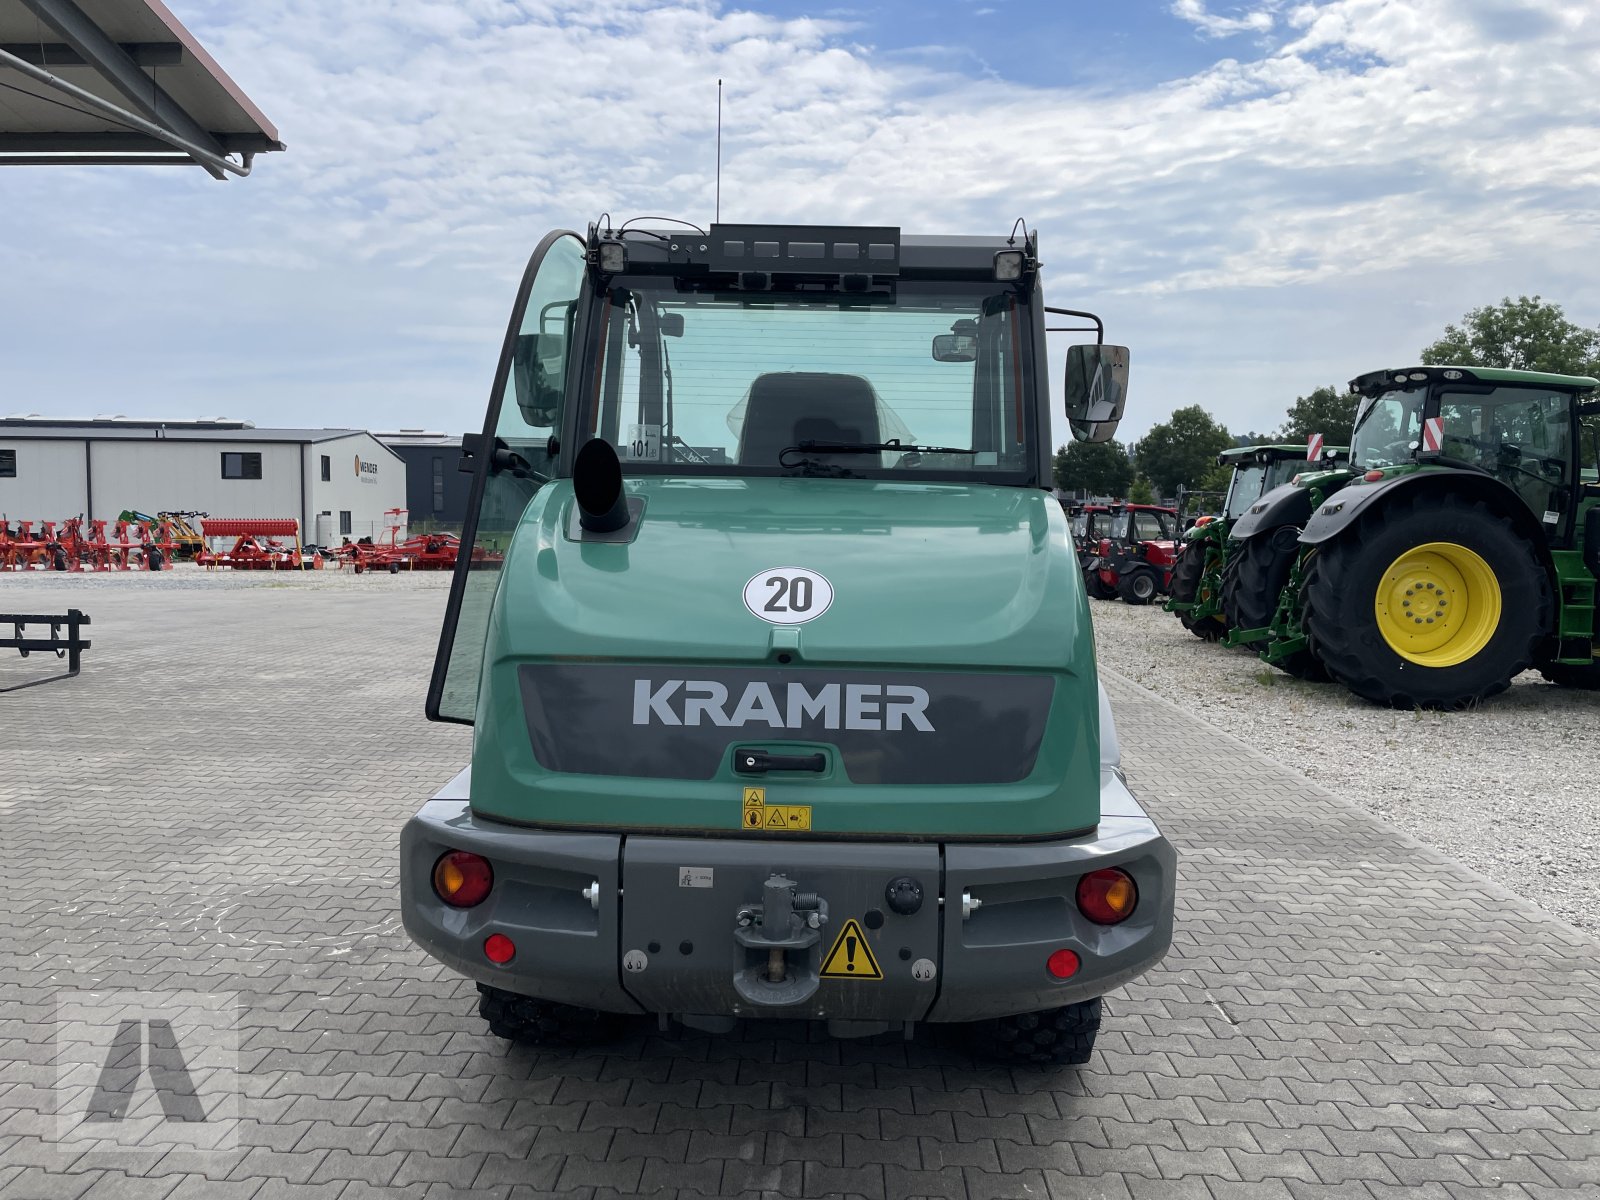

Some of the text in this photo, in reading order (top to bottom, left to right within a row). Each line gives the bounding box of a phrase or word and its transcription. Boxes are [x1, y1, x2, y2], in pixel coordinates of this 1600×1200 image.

[632, 439, 649, 457] 101
[360, 461, 378, 474] WENDER
[763, 576, 813, 613] 20
[632, 679, 936, 732] KRAMER
